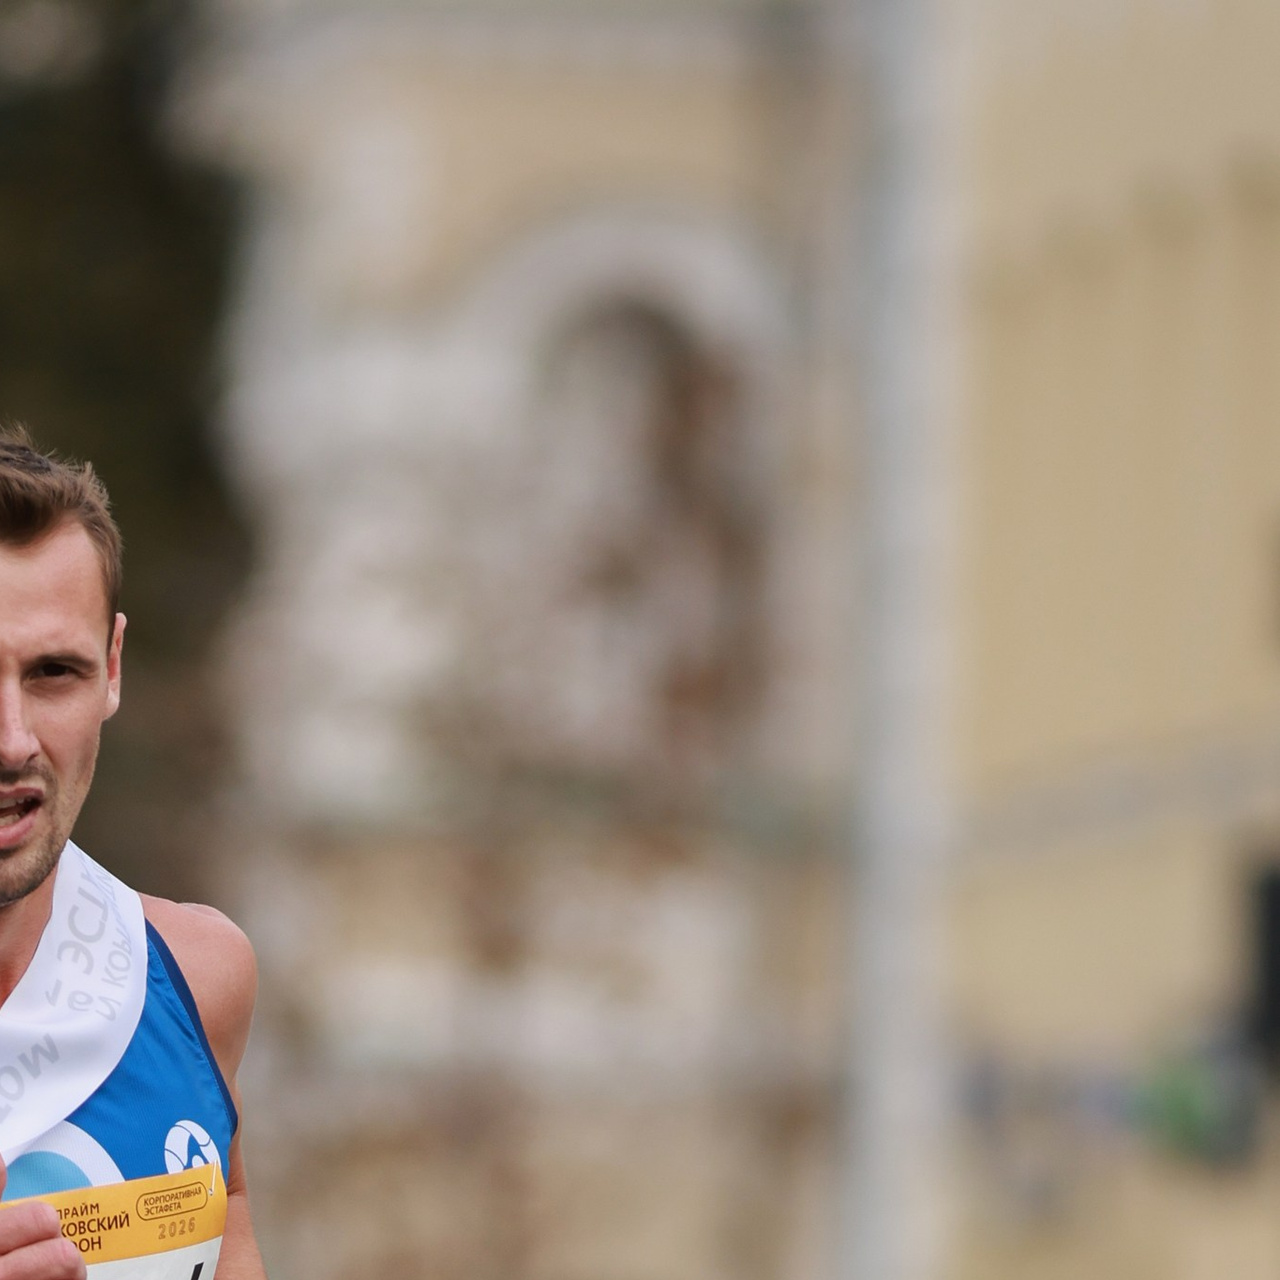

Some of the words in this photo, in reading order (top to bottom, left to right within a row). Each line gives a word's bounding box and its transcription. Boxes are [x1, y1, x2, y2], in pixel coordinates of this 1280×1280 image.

[143, 1186, 202, 1206] КОРПОРАТИВНАЯ
[144, 1203, 182, 1216] ЭСТАФЕТА
[158, 1217, 197, 1240] 2026
[71, 1236, 102, 1252] ОН
